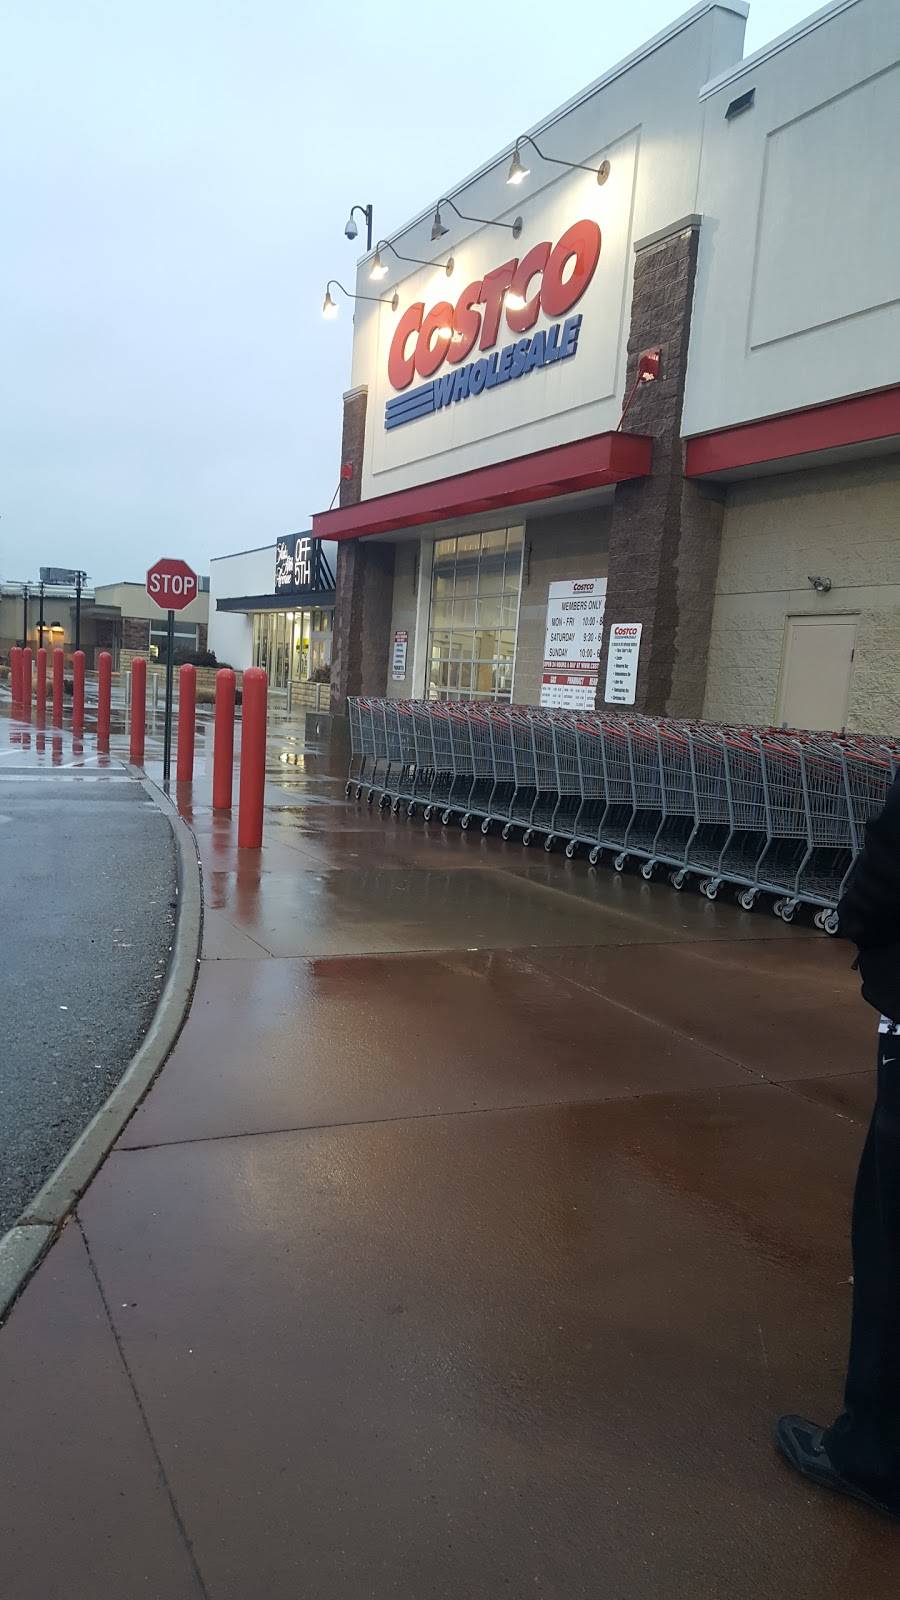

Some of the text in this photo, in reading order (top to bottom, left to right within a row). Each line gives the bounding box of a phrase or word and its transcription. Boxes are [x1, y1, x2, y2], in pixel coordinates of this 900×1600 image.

[388, 219, 601, 390] COSTCO
[433, 314, 583, 409] WHOLESALE
[295, 537, 311, 562] OFF
[295, 560, 310, 585] 5TH
[150, 573, 194, 595] STOP
[561, 600, 602, 611] MEMBERS ONLY
[551, 617, 562, 626] MON
[566, 617, 575, 626] FRI
[550, 633, 575, 642] SATURDAY
[614, 626, 637, 635] COSTCO
[549, 648, 568, 657] SUNDAY
[579, 649, 592, 658] 10:00
